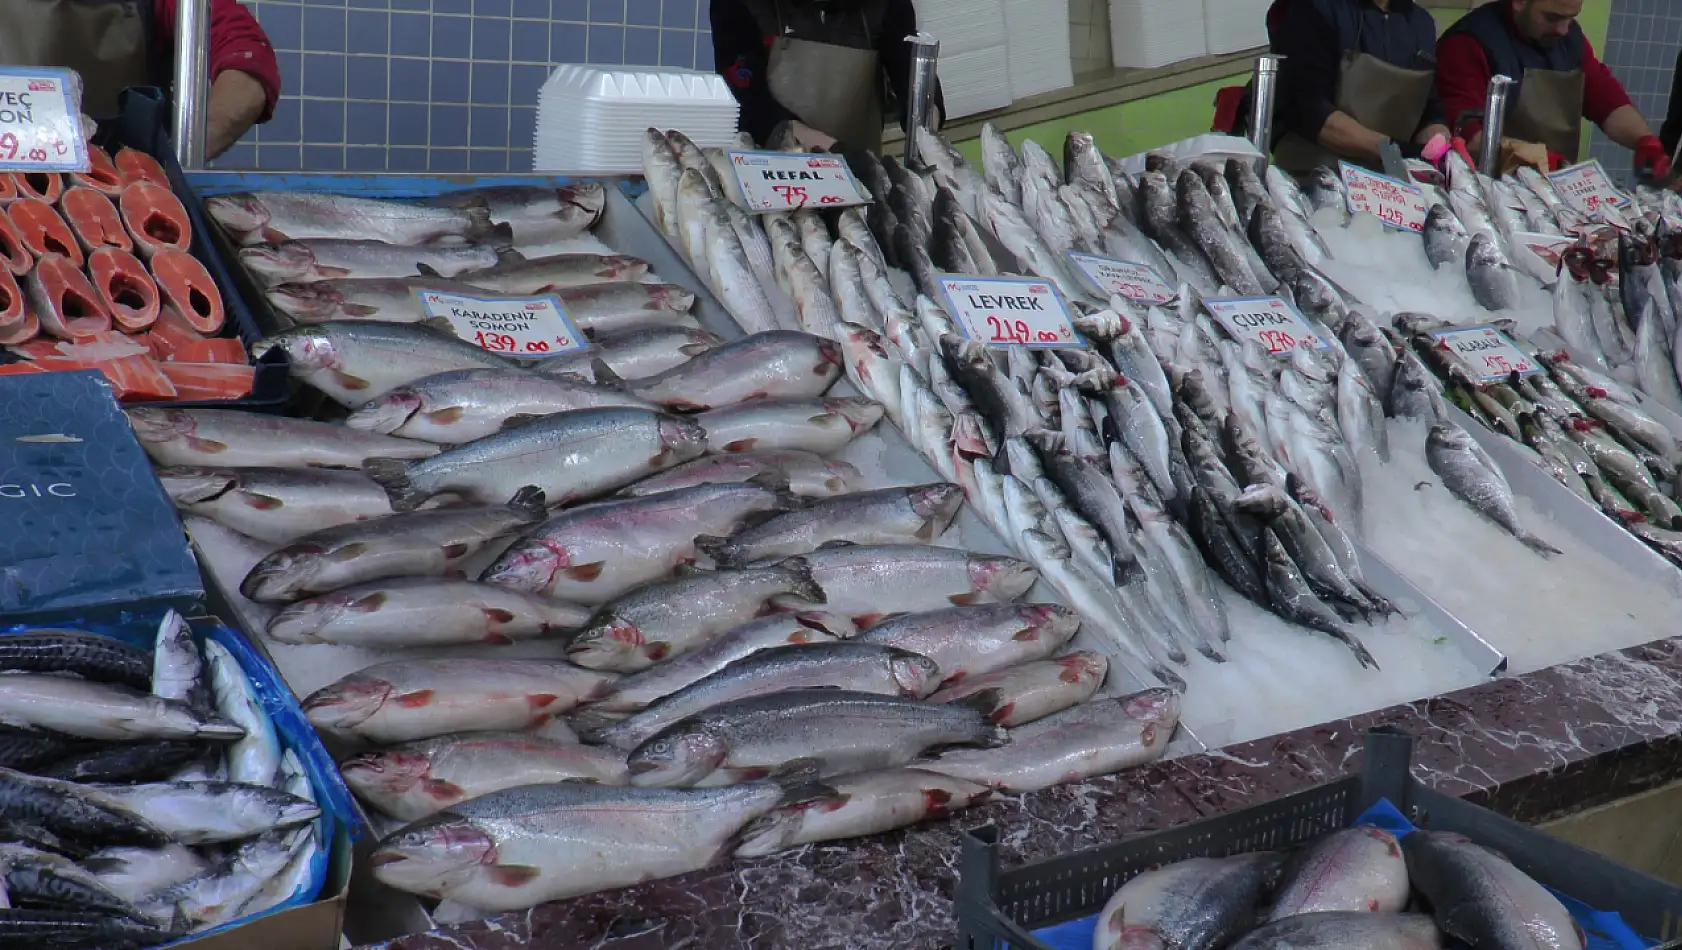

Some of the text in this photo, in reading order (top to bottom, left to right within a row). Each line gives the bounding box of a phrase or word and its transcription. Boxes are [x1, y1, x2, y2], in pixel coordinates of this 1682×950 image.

[762, 169, 824, 180] KEFAL
[968, 294, 1045, 311] LEVREK
[451, 307, 538, 321] KARADENİZ
[469, 320, 530, 332] SOMON
[1232, 312, 1295, 332] ÇUPRA
